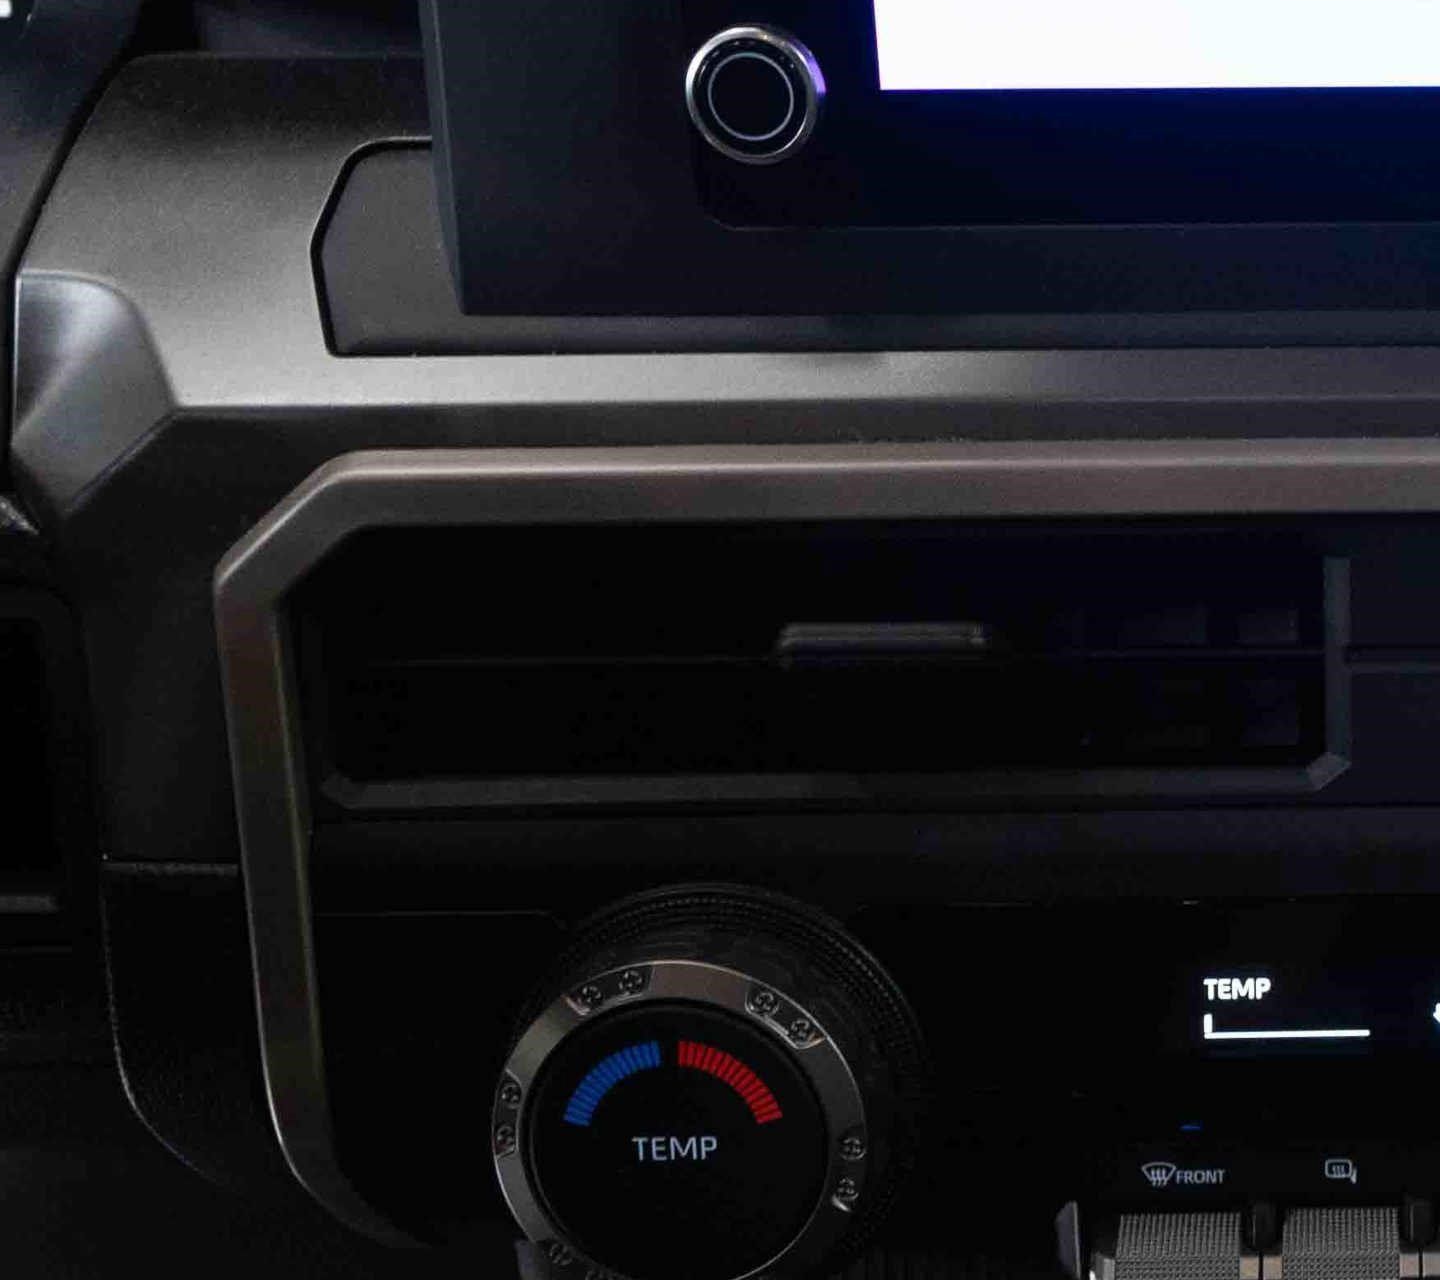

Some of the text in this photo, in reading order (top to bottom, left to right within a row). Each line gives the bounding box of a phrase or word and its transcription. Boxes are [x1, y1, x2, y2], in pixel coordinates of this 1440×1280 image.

[1203, 977, 1271, 1000] TEMP
[632, 1135, 718, 1161] TEMP
[1176, 1169, 1226, 1185] FRONT
